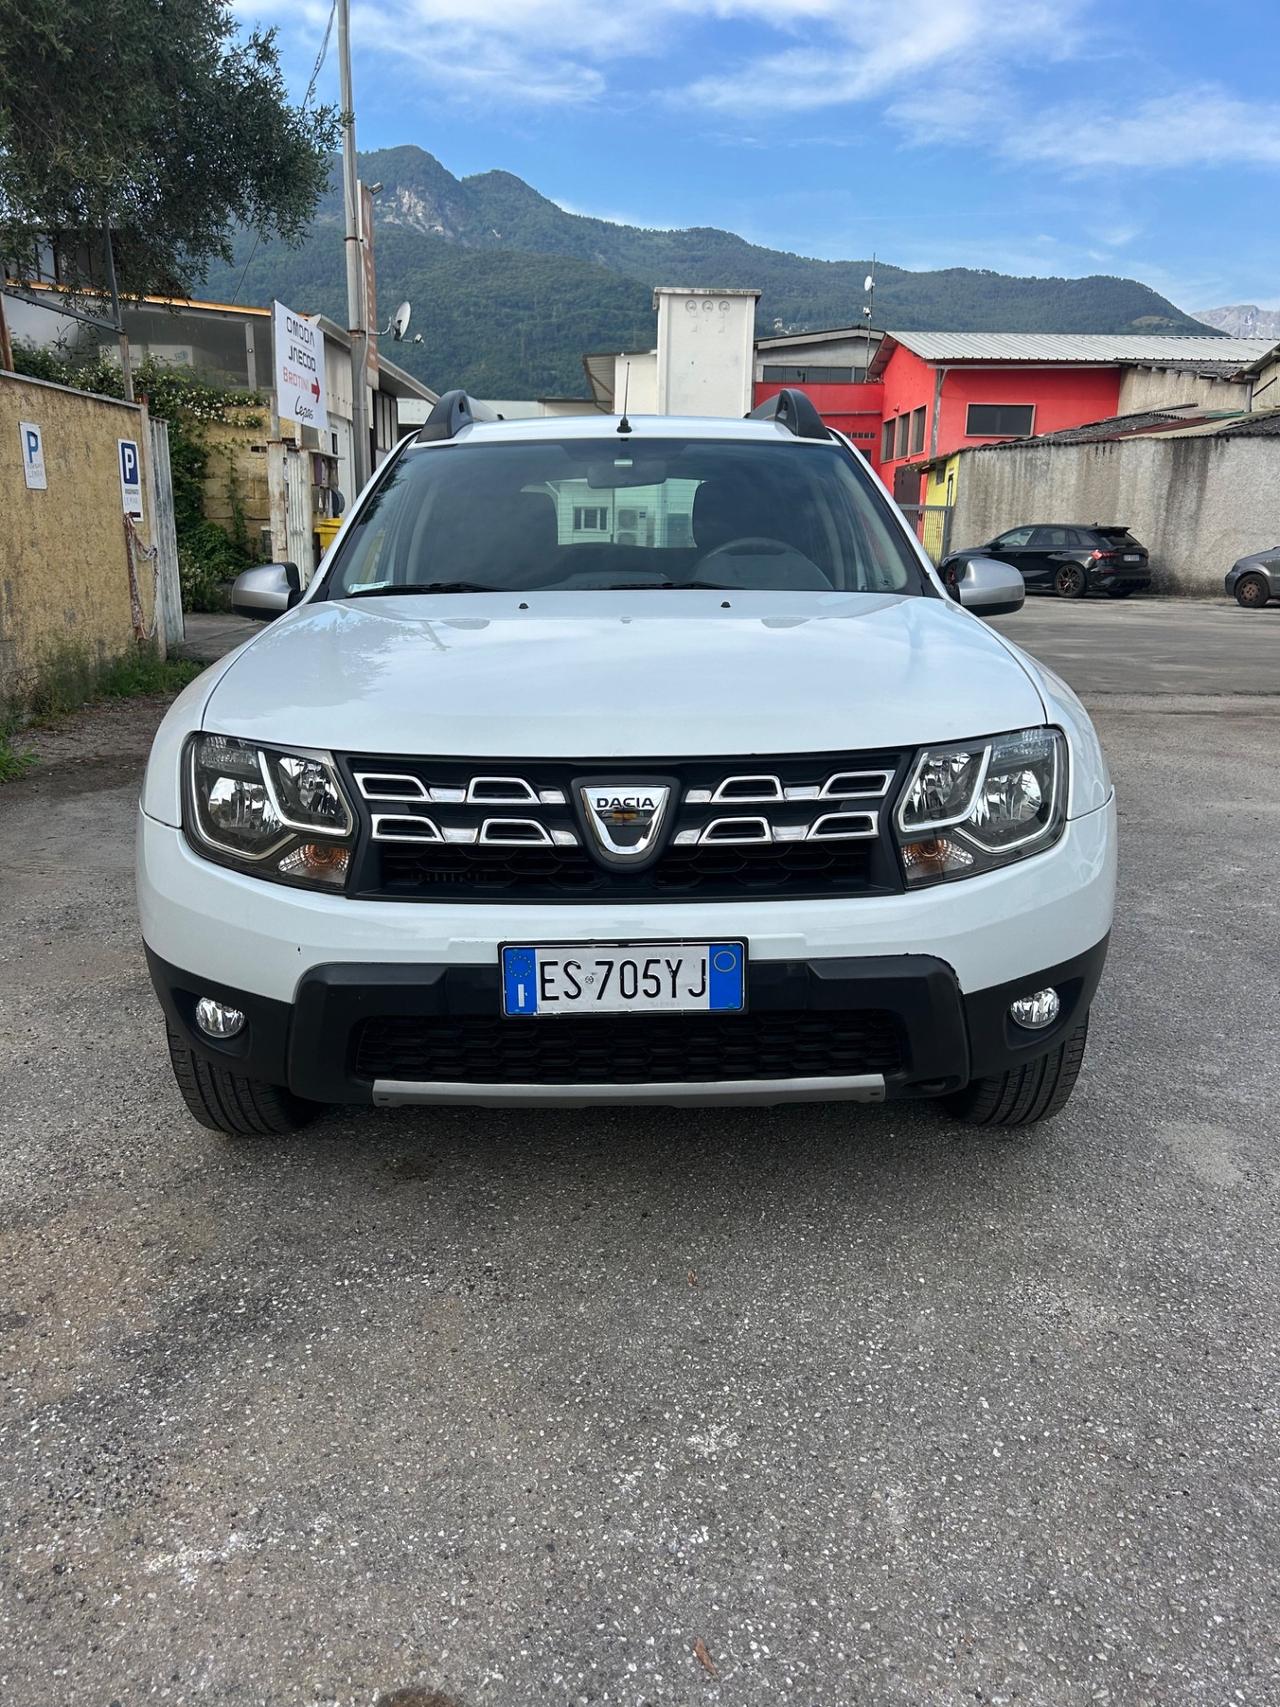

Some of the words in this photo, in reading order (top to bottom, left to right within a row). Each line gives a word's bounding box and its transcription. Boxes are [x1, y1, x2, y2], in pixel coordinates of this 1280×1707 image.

[26, 430, 39, 464] P
[124, 447, 135, 480] P
[596, 797, 655, 809] DACIA
[518, 983, 525, 1008] I
